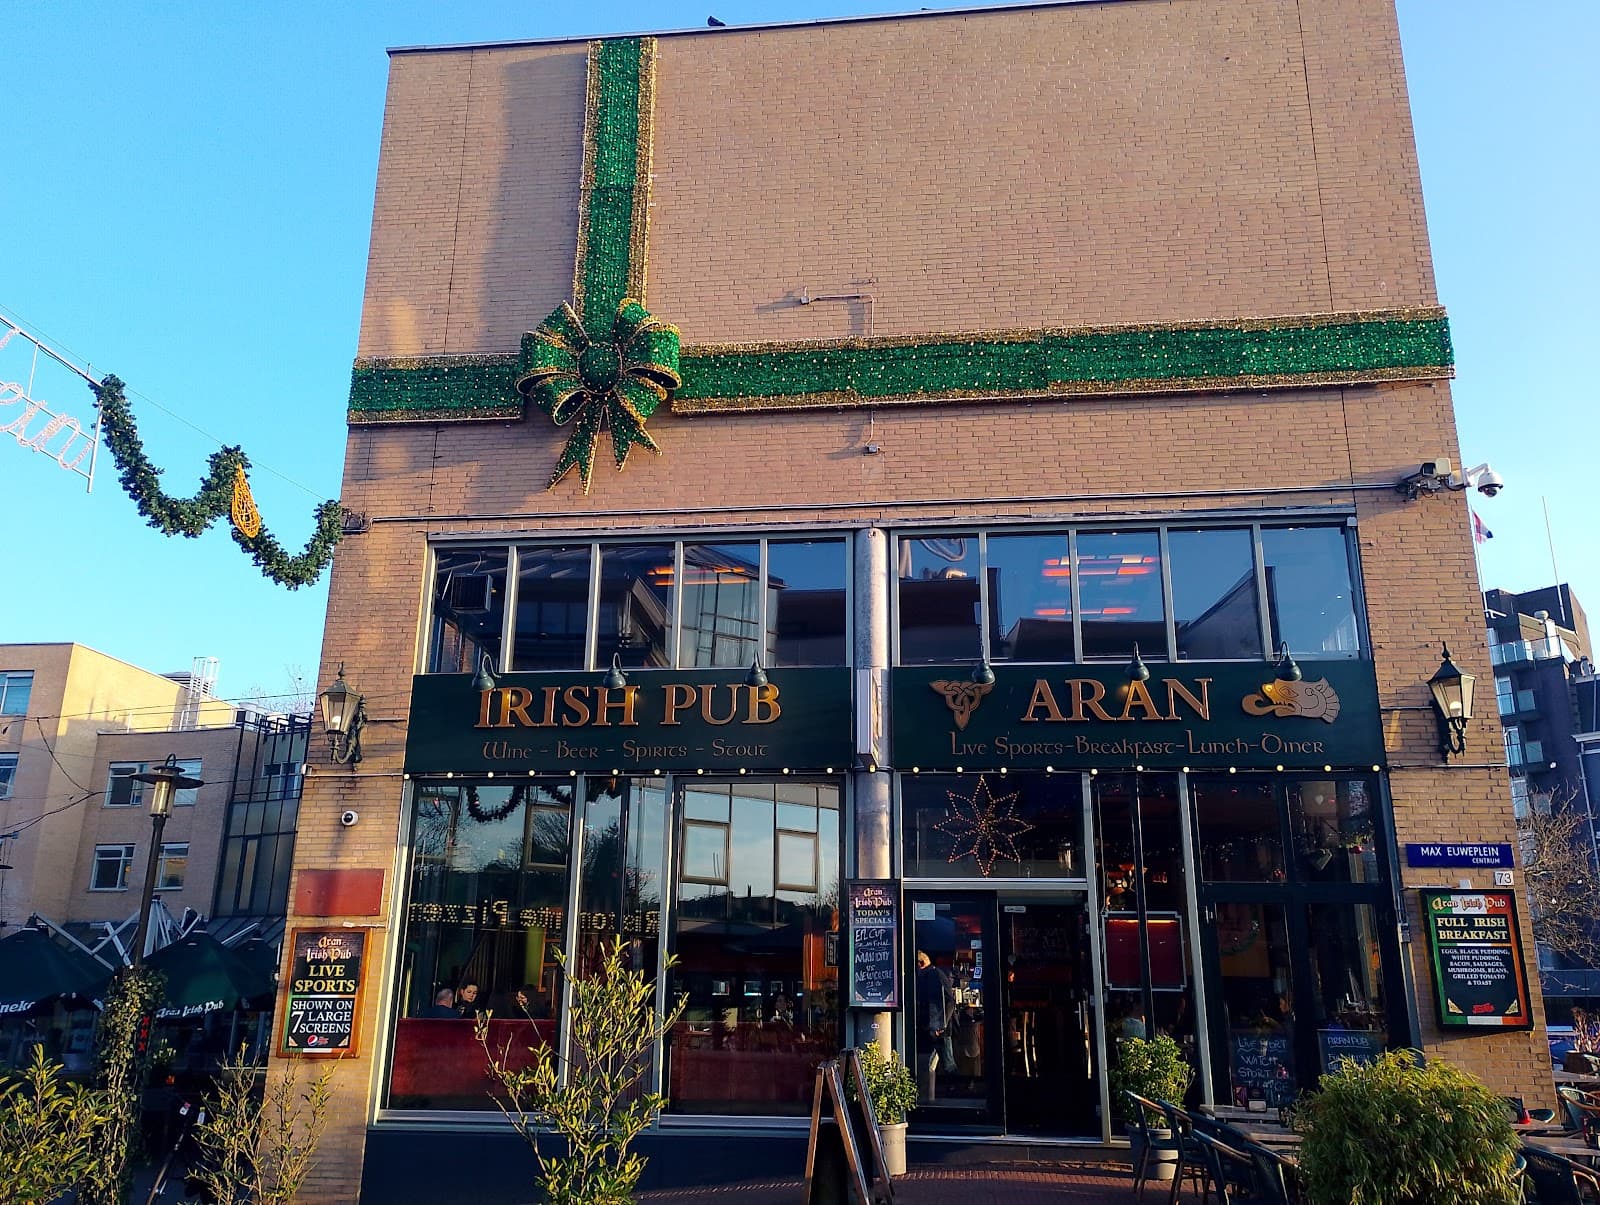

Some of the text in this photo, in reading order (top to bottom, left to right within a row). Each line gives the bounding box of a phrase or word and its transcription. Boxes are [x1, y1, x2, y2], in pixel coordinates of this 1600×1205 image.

[474, 682, 781, 728] IRISH PUB
[1020, 677, 1213, 721] ARAN
[1420, 846, 1499, 857] MAX EUWEPLEIN
[1496, 872, 1512, 884] 73
[1432, 897, 1458, 910] Aran
[1484, 897, 1506, 910] Pub
[1436, 918, 1506, 926] FULL IRISH
[1438, 930, 1508, 940] BREAKFAST
[318, 936, 342, 948] Aran
[306, 948, 352, 962] Irish Pub
[308, 965, 345, 977] LIVE
[294, 980, 356, 993] SPORTS
[204, 1000, 224, 1014] Pub
[292, 1000, 353, 1010] SHOWN ON
[290, 1011, 352, 1034] 7 LARGE
[300, 1023, 350, 1034] SCREENS
